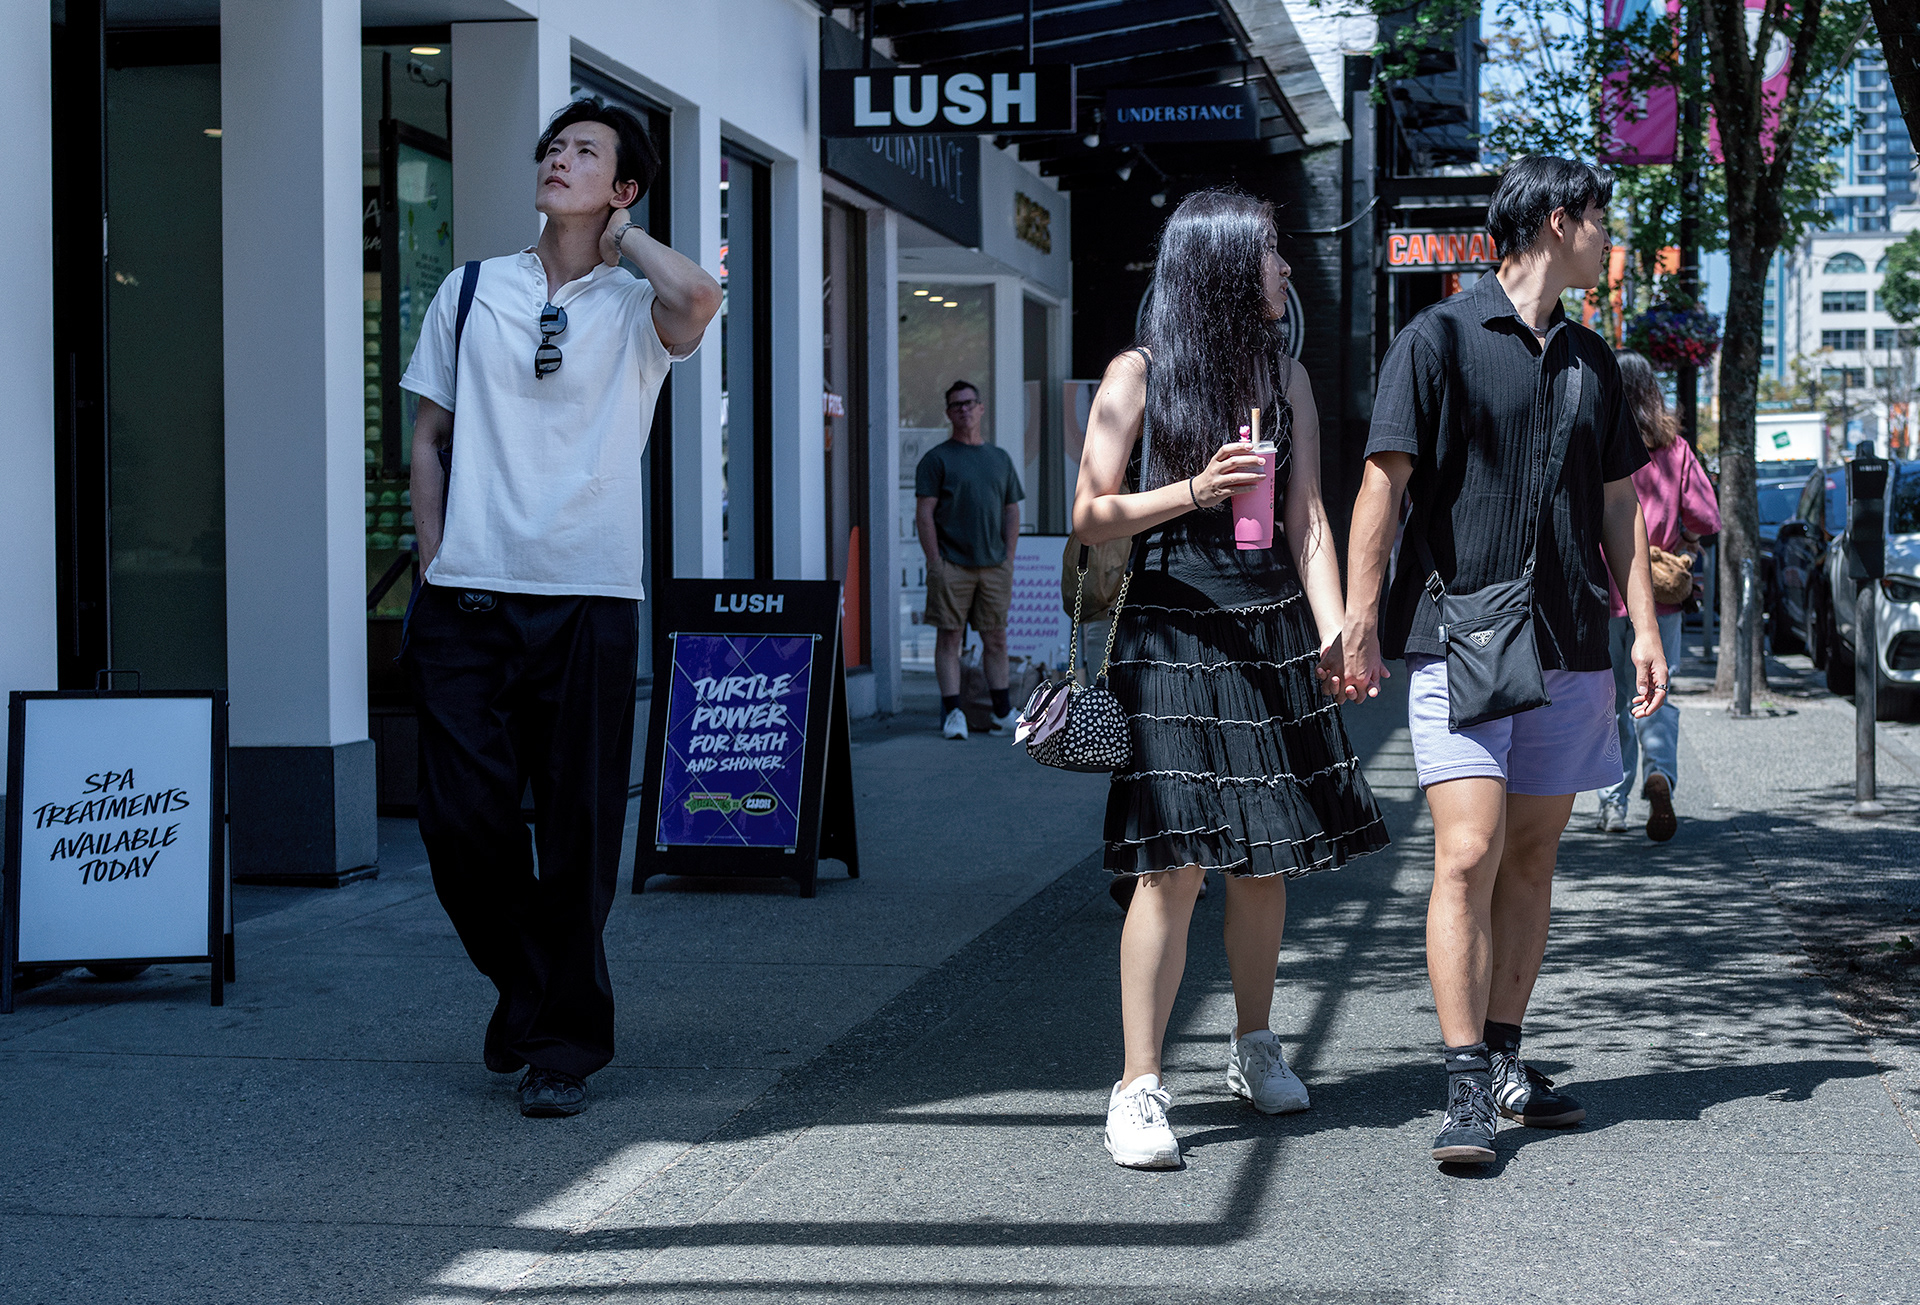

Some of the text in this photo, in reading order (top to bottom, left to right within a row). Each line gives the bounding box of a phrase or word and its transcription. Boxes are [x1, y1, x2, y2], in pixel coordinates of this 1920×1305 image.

[853, 72, 1037, 127] LUSH
[1117, 103, 1245, 123] UNDERSTANCE
[714, 594, 784, 613] LUSH
[693, 673, 792, 702] TURTLE
[691, 704, 788, 731] POWER
[688, 732, 788, 754] FOR BATH
[685, 755, 786, 773] AND SHOWER.
[82, 768, 135, 795] SPA
[32, 788, 190, 829] TREATMENTS
[50, 823, 181, 861] AVAILABLE
[78, 850, 160, 885] TODAY
